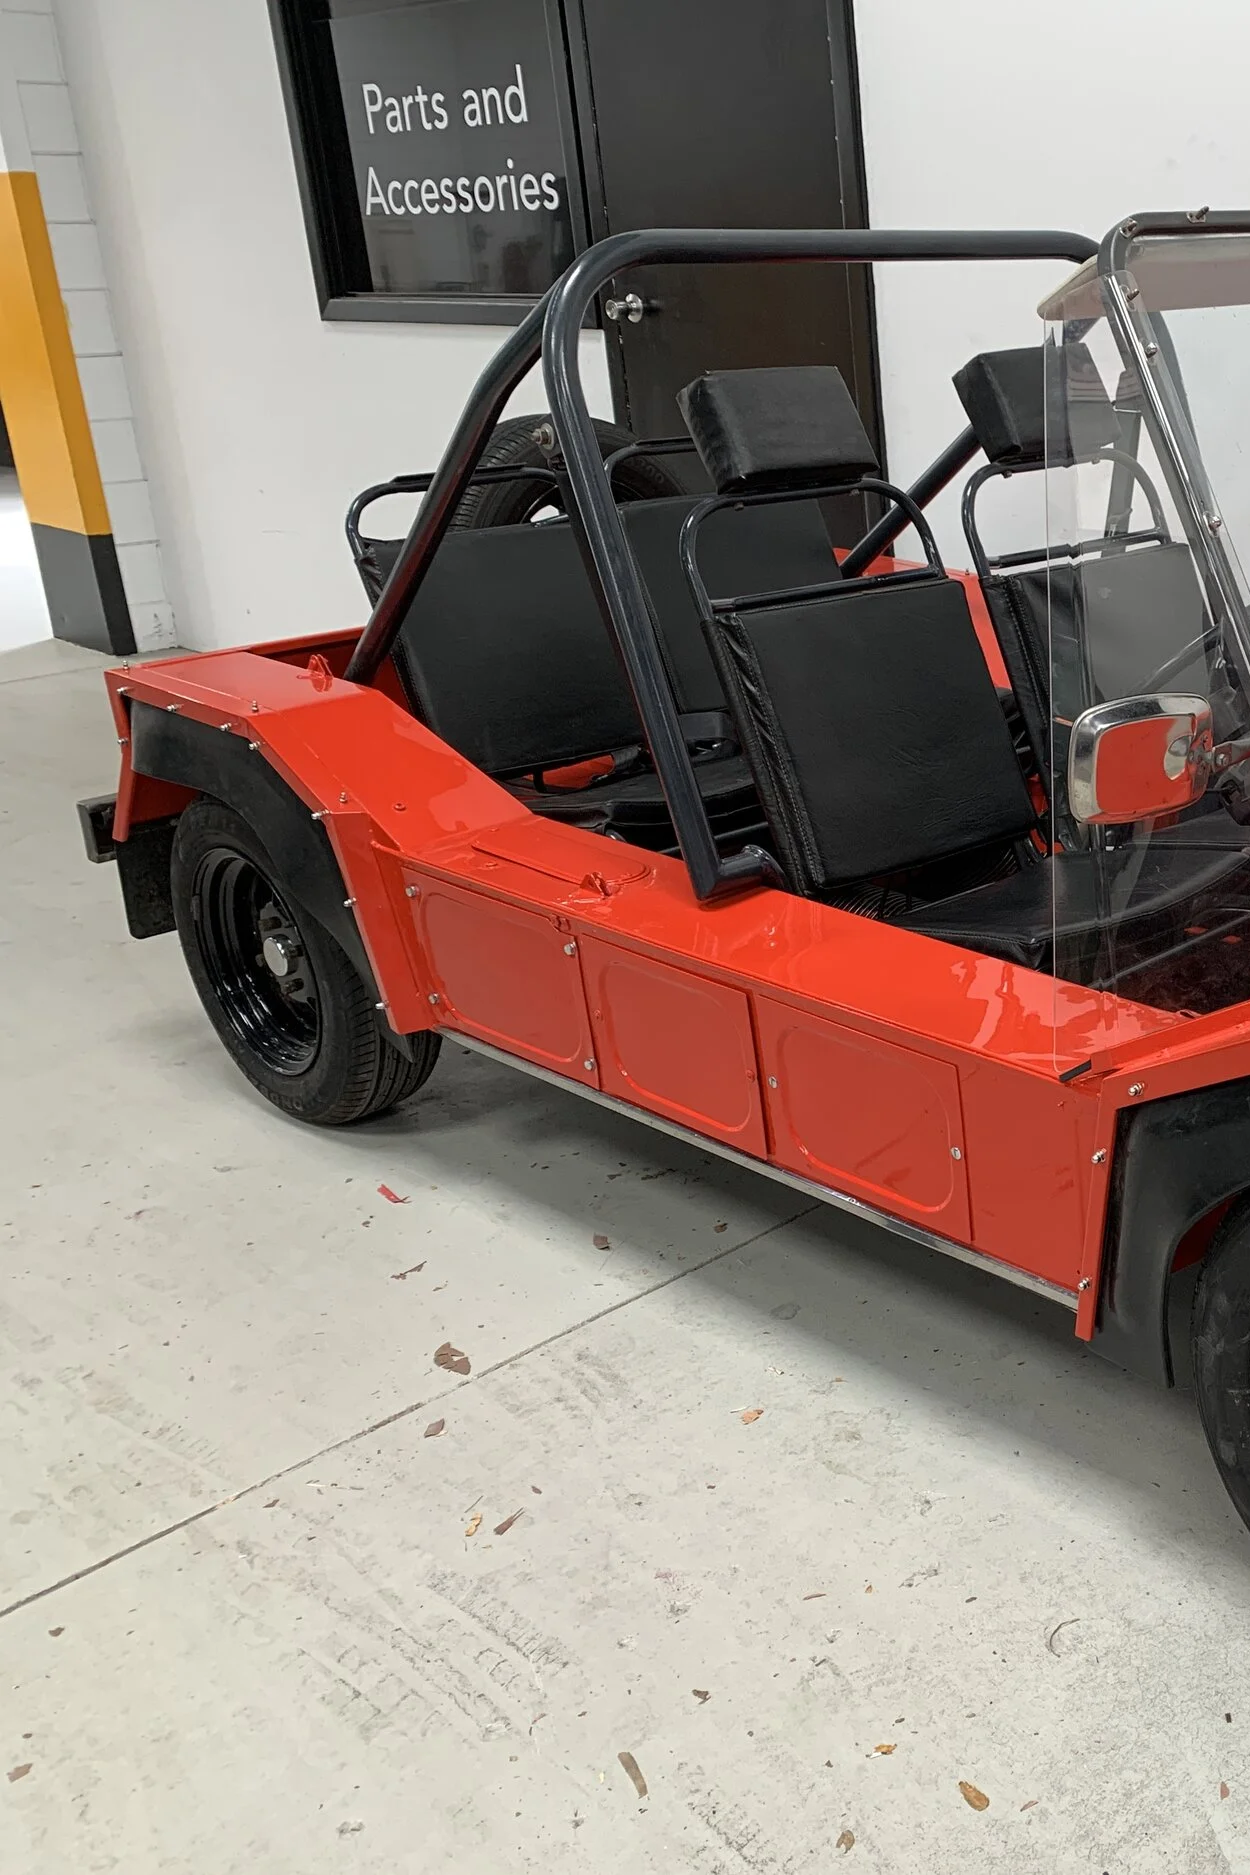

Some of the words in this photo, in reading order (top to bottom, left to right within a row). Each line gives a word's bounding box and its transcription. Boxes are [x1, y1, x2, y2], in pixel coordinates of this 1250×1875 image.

[361, 82, 449, 135] Parts
[461, 63, 529, 128] and
[365, 157, 560, 216] Accessories
